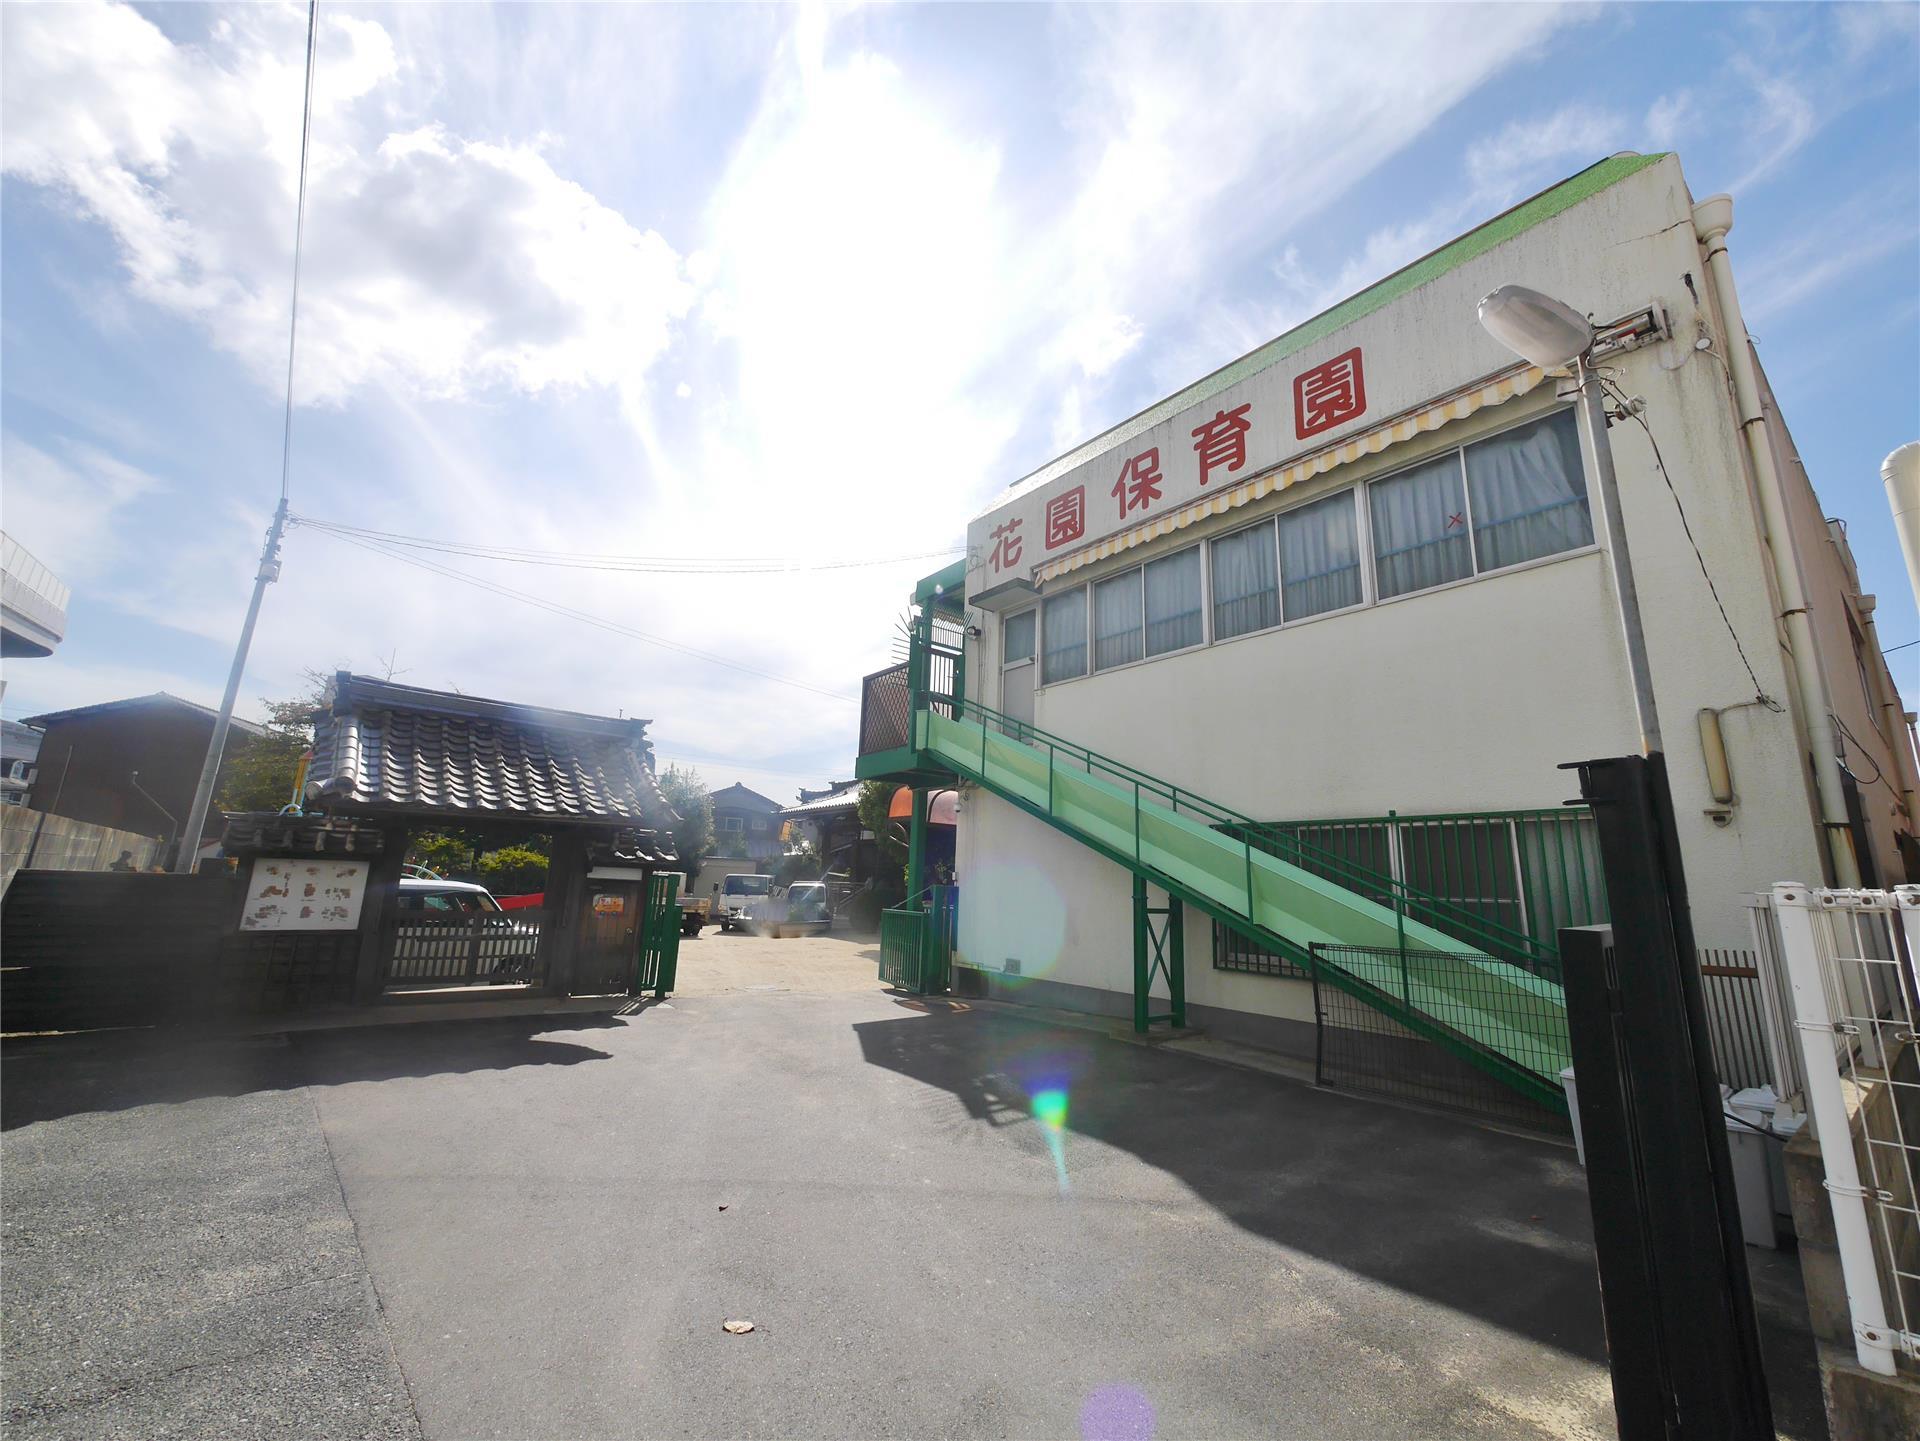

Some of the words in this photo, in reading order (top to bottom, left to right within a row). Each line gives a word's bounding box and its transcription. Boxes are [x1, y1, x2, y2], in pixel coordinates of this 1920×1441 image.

[989, 346, 1367, 573] 花園保育園
